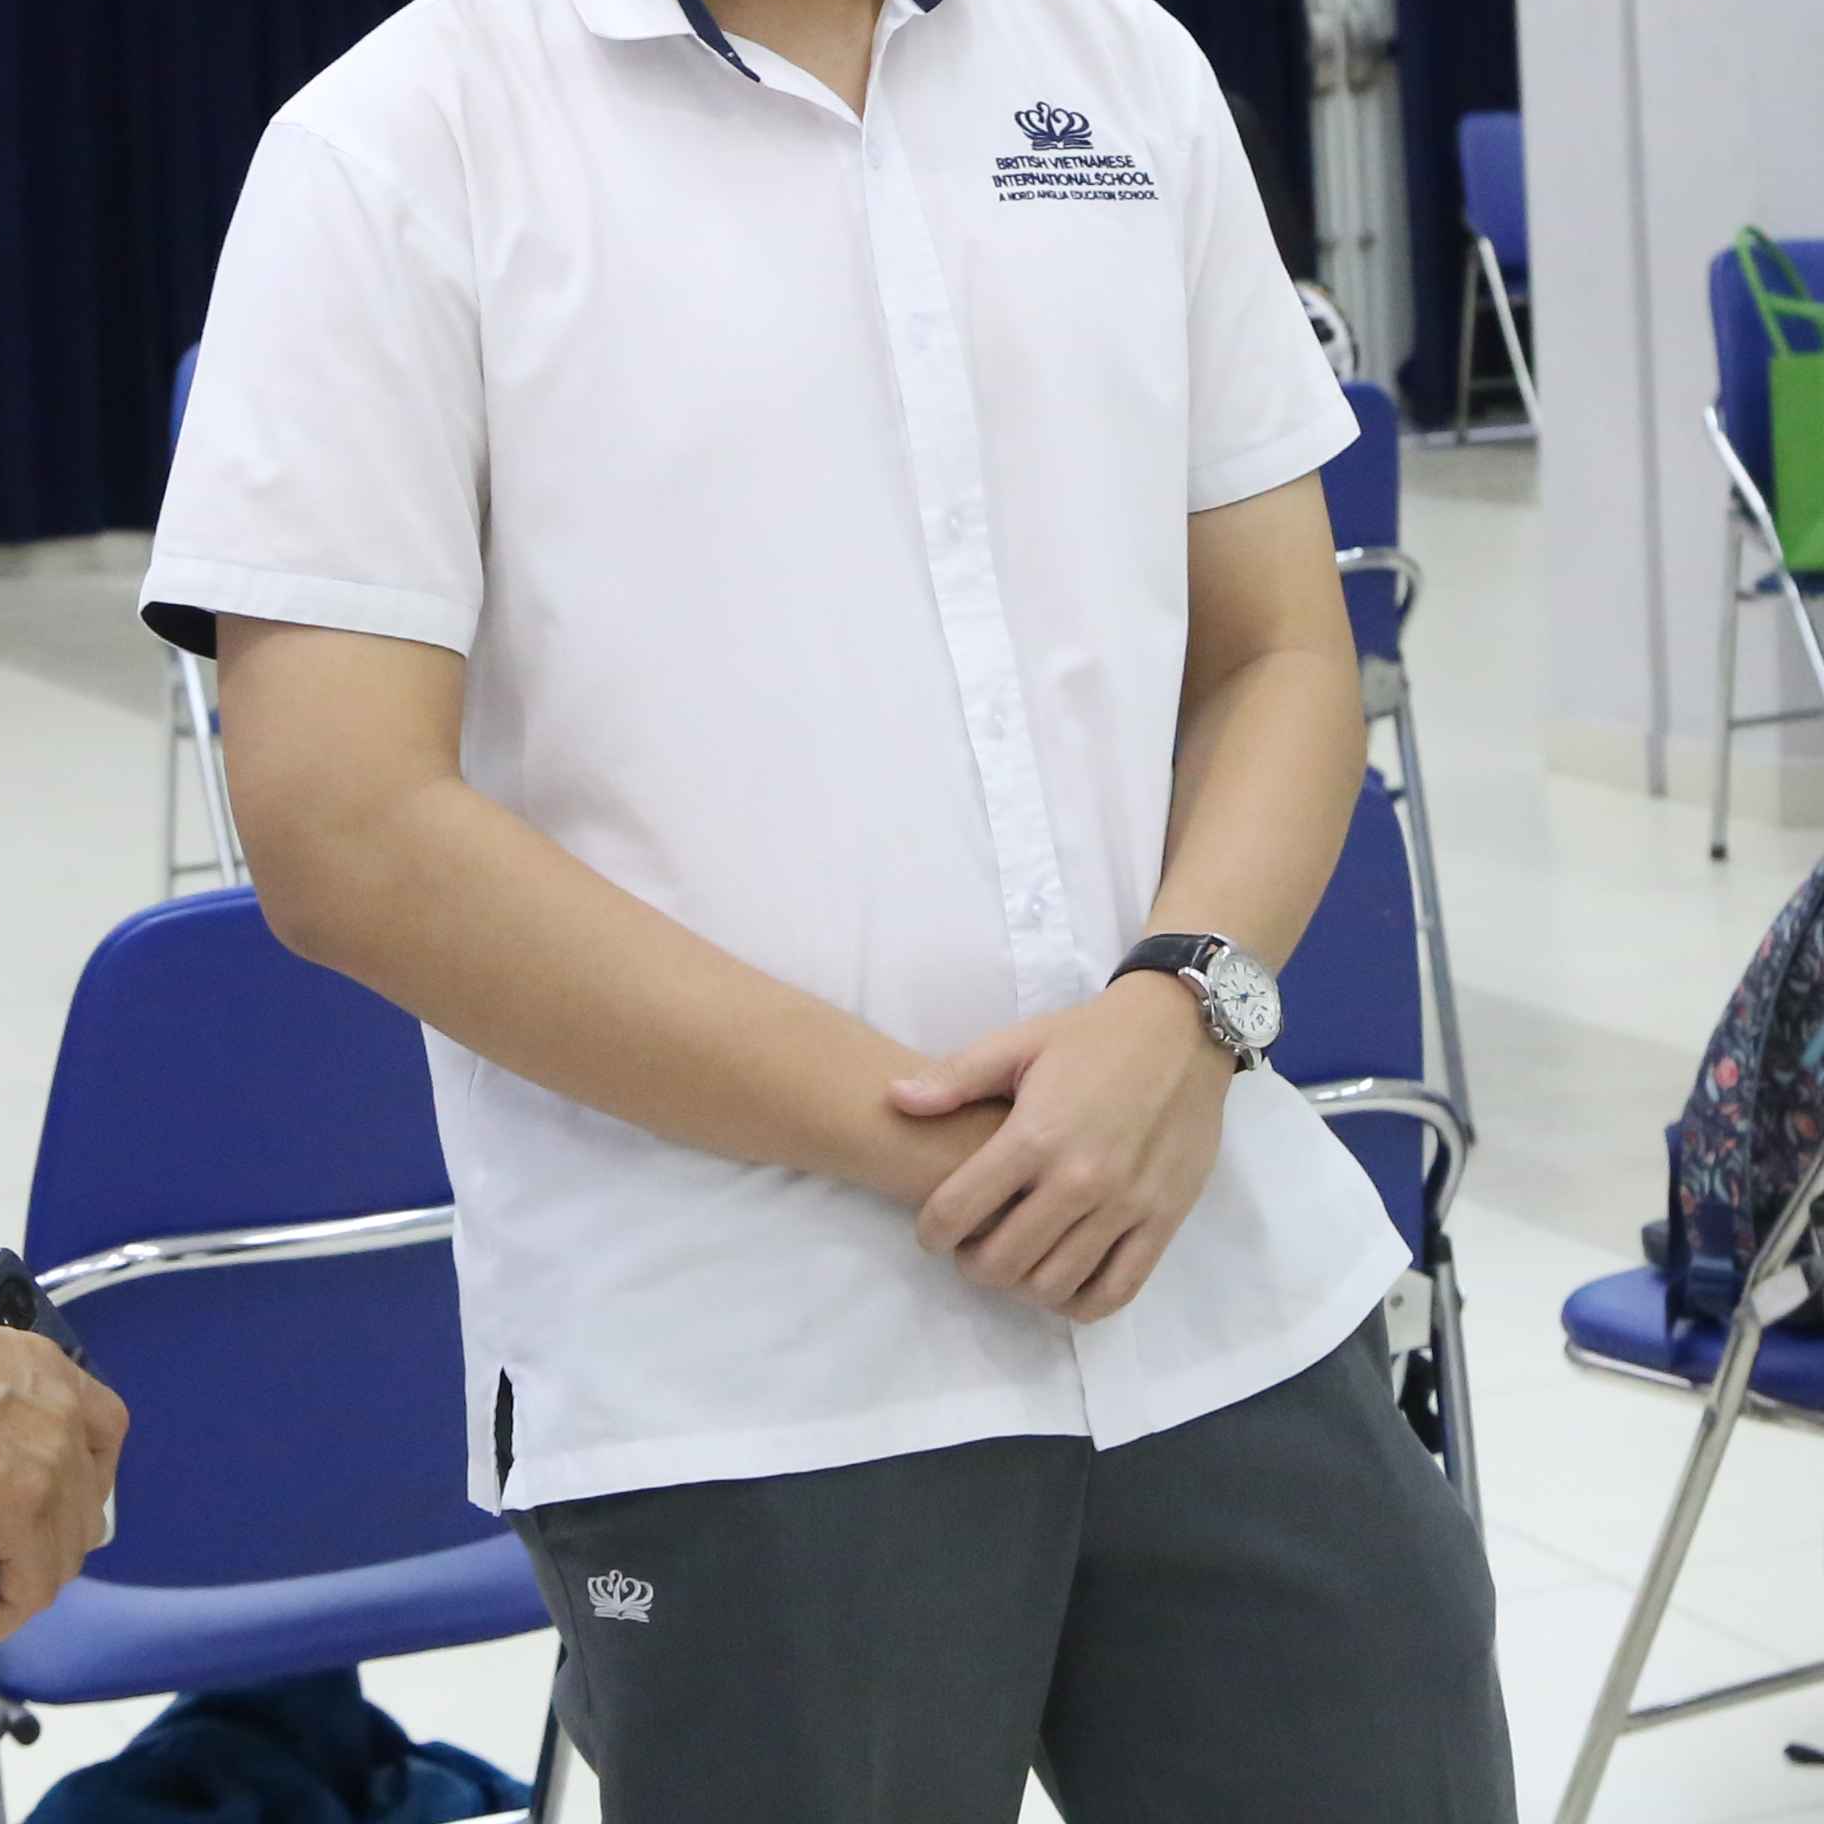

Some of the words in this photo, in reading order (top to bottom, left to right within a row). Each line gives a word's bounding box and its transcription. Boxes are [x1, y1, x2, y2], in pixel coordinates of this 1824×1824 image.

[995, 155, 1048, 170] BRITISH
[1047, 155, 1136, 169] VIETNAMESE
[992, 172, 1095, 188] INTERNATIONAL
[1094, 172, 1155, 186] SCHOOL
[999, 192, 1007, 202] A
[1117, 190, 1159, 201] SCHOOL
